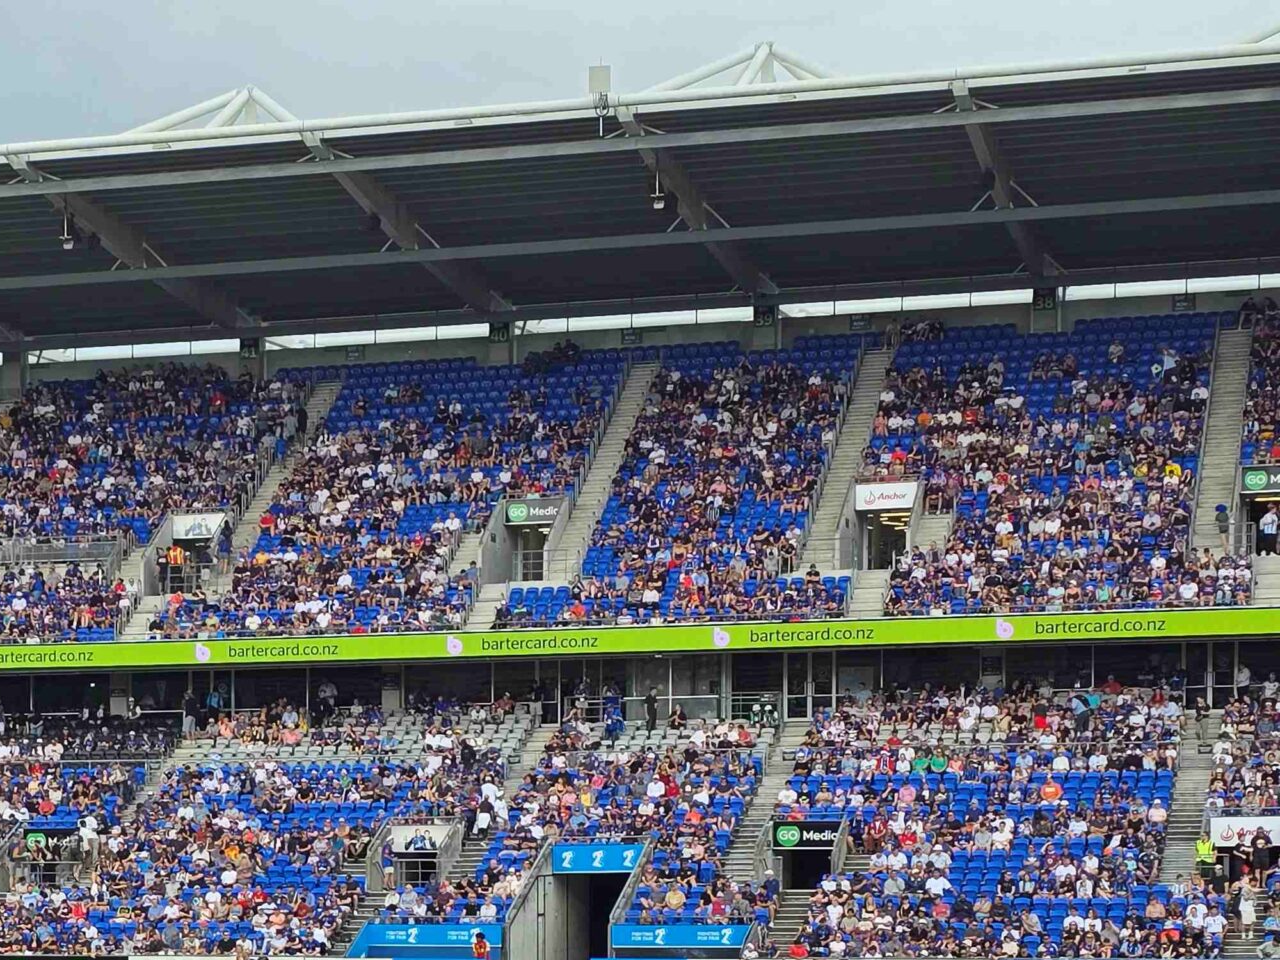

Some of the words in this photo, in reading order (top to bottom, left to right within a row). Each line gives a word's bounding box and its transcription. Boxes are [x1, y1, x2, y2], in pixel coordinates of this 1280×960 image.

[1247, 475, 1266, 484] GO
[877, 492, 907, 500] Anchor
[510, 508, 526, 517] GO
[1034, 617, 1167, 635] bartercard.co.nz
[749, 626, 875, 643] bartercard.co.nz
[481, 635, 599, 651] bartercard.co.nz
[228, 642, 339, 659] bartercard.co.nz
[779, 830, 798, 840] GO
